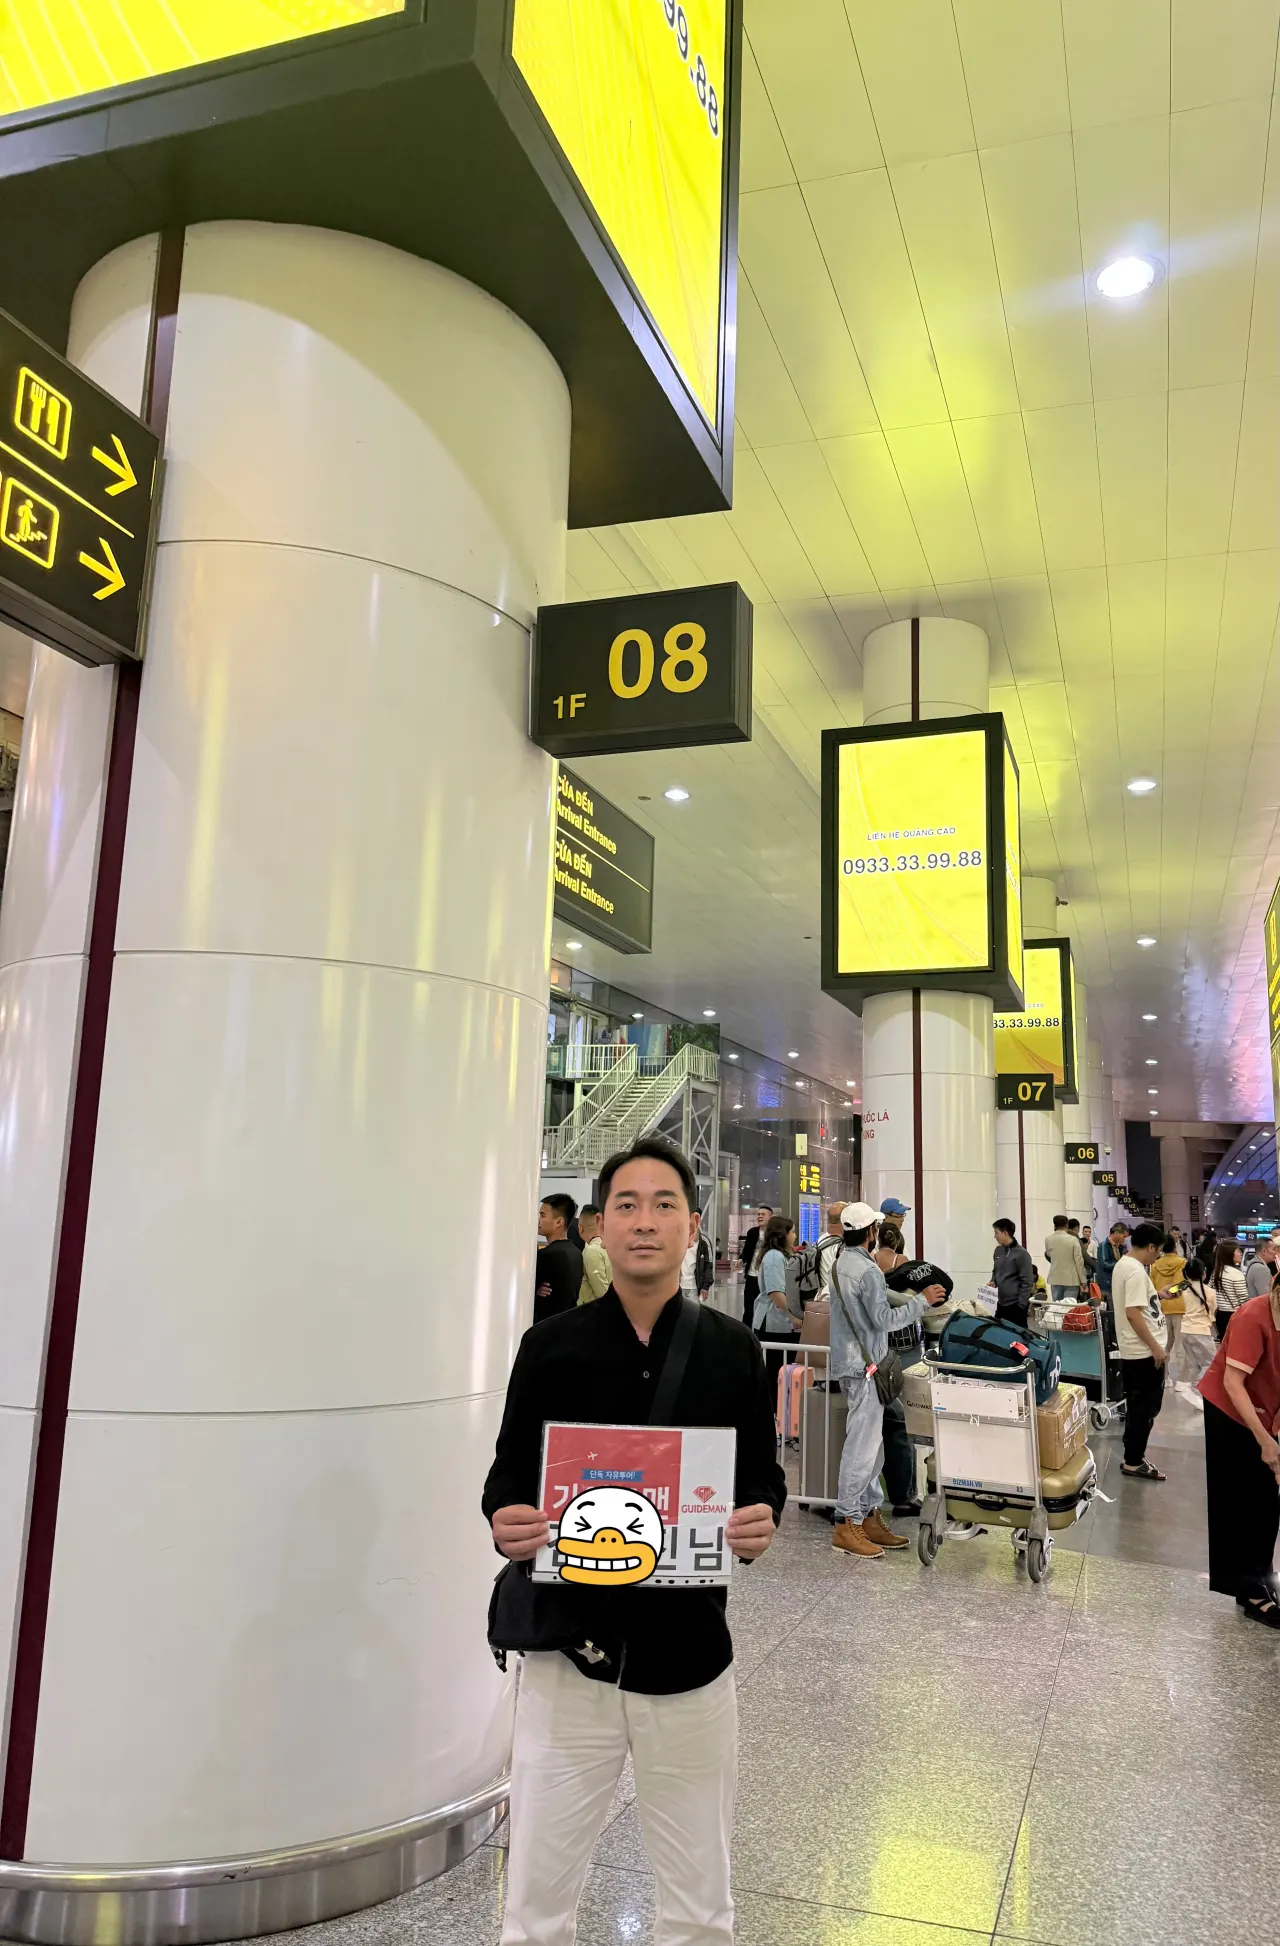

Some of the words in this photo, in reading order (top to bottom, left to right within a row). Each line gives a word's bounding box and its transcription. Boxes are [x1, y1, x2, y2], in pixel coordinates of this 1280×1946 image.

[553, 693, 587, 719] 1F
[608, 622, 708, 699] 08
[556, 798, 582, 832] Arrival
[583, 819, 617, 855] Entrance
[843, 850, 982, 875] 0933.33.99.88
[553, 865, 579, 894] Arrival
[580, 881, 614, 914] Entrance
[1003, 1097, 1013, 1105] 1F
[1017, 1081, 1047, 1101] 07
[1077, 1147, 1095, 1159] 06
[1102, 1174, 1114, 1183] 05
[681, 1504, 727, 1514] GUIDEMAN
